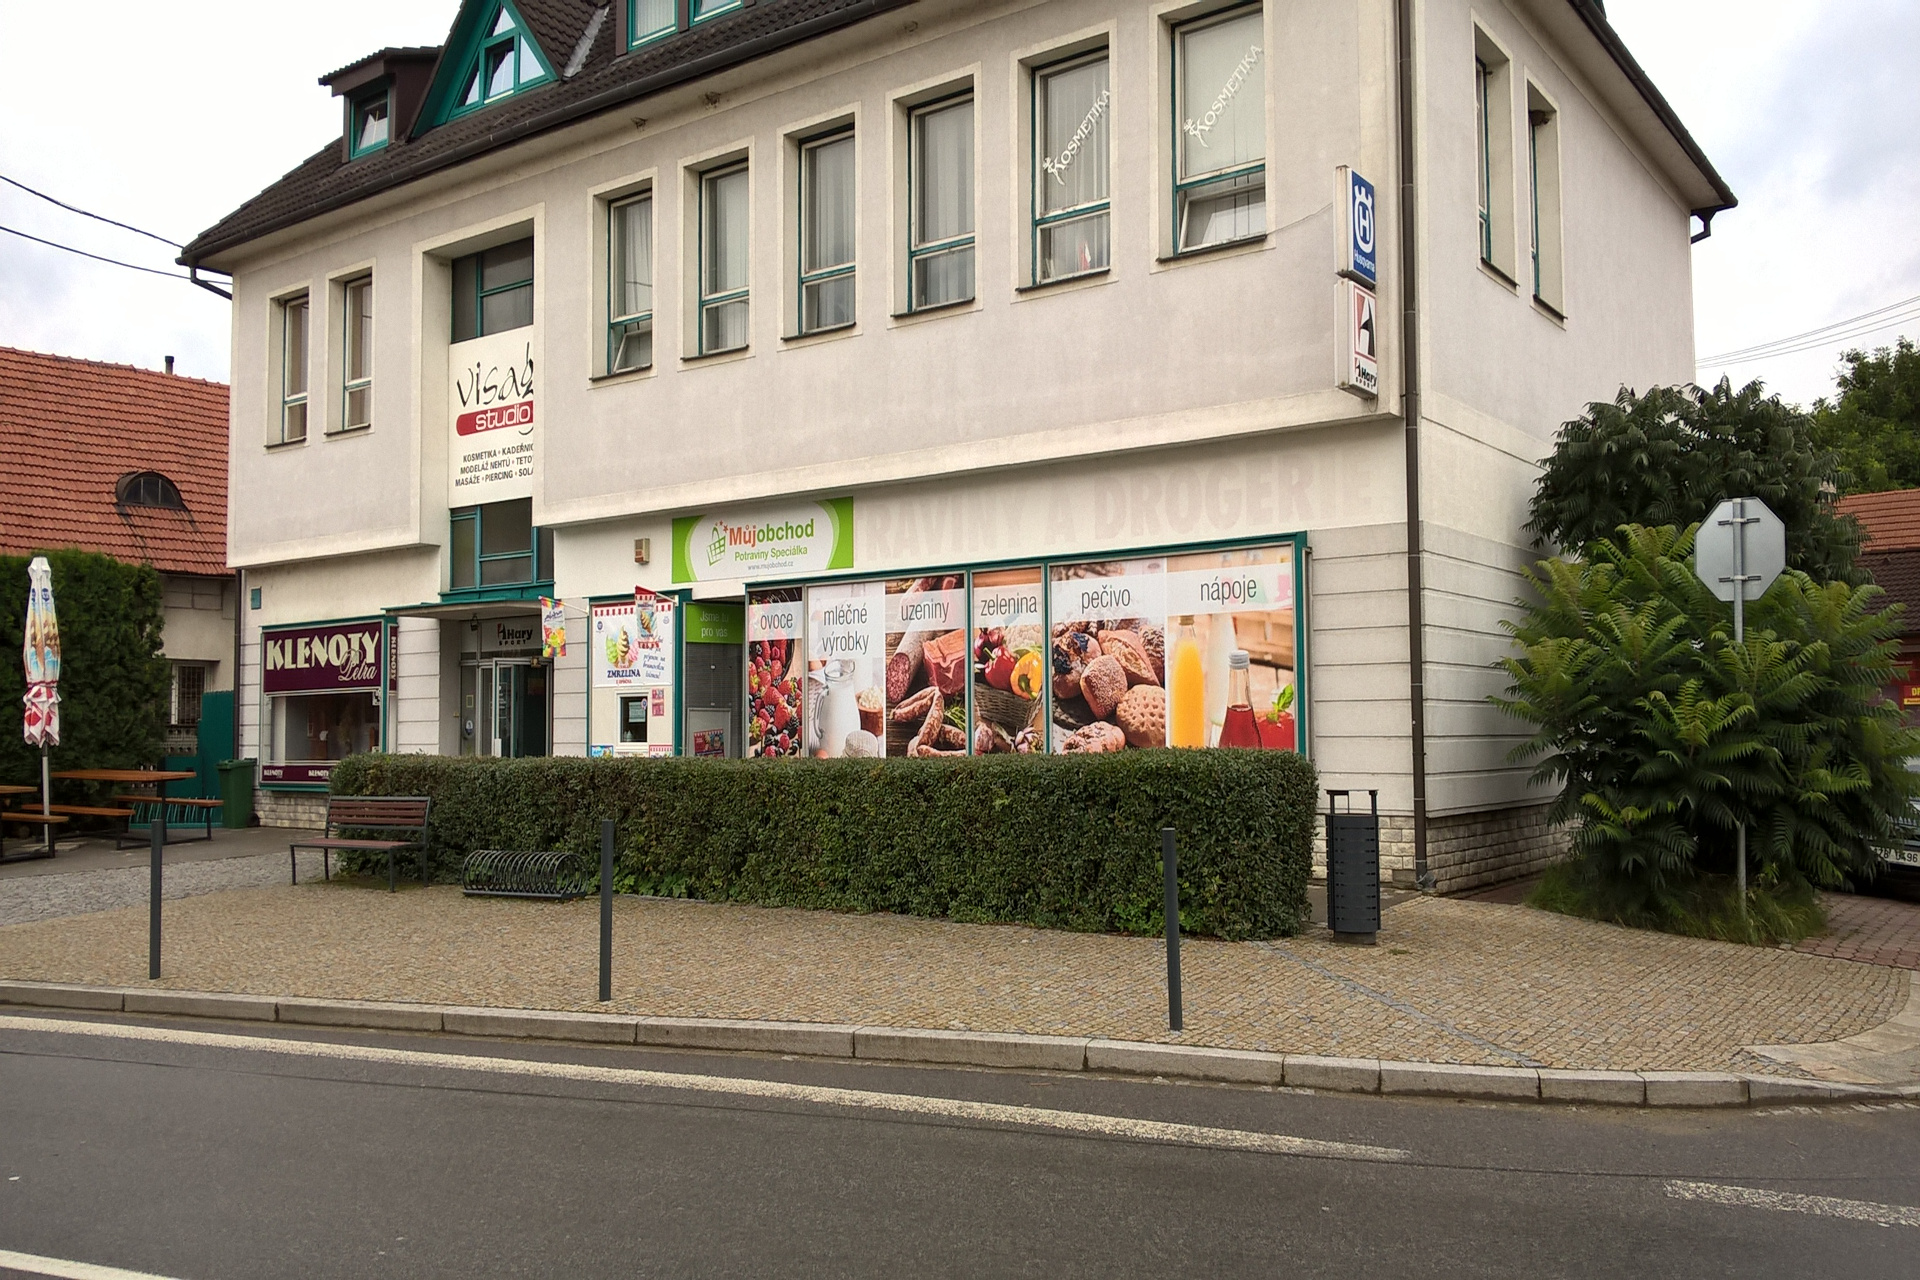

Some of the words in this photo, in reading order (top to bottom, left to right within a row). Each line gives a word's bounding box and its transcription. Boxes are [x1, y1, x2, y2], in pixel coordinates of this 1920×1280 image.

[1188, 43, 1263, 148] KOSMETIKA
[1045, 89, 1111, 186] KOSMETIKA
[475, 404, 531, 432] studio
[460, 460, 489, 475] MODELÁŽ
[516, 455, 534, 466] TETO
[463, 449, 497, 463] KOSMETIKA
[455, 473, 480, 487] MASÁŽE
[484, 469, 514, 482] PIERCING
[728, 518, 815, 548] Můjobchod
[734, 548, 769, 562] Potraviny
[770, 545, 808, 561] Speciálka
[747, 560, 794, 571] www.mujobchod.cz
[1080, 584, 1131, 614] pečivo
[1199, 575, 1257, 605] nápoje
[823, 602, 868, 627] mléčné
[900, 599, 950, 624] uzeniny
[980, 592, 1038, 617] zelenina
[701, 627, 714, 639] pro
[760, 611, 793, 631] ovoce
[508, 629, 533, 640] Hary
[821, 630, 869, 657] výrobky
[266, 631, 379, 671] KLENOTY
[607, 668, 641, 679] ZMRZLINA
